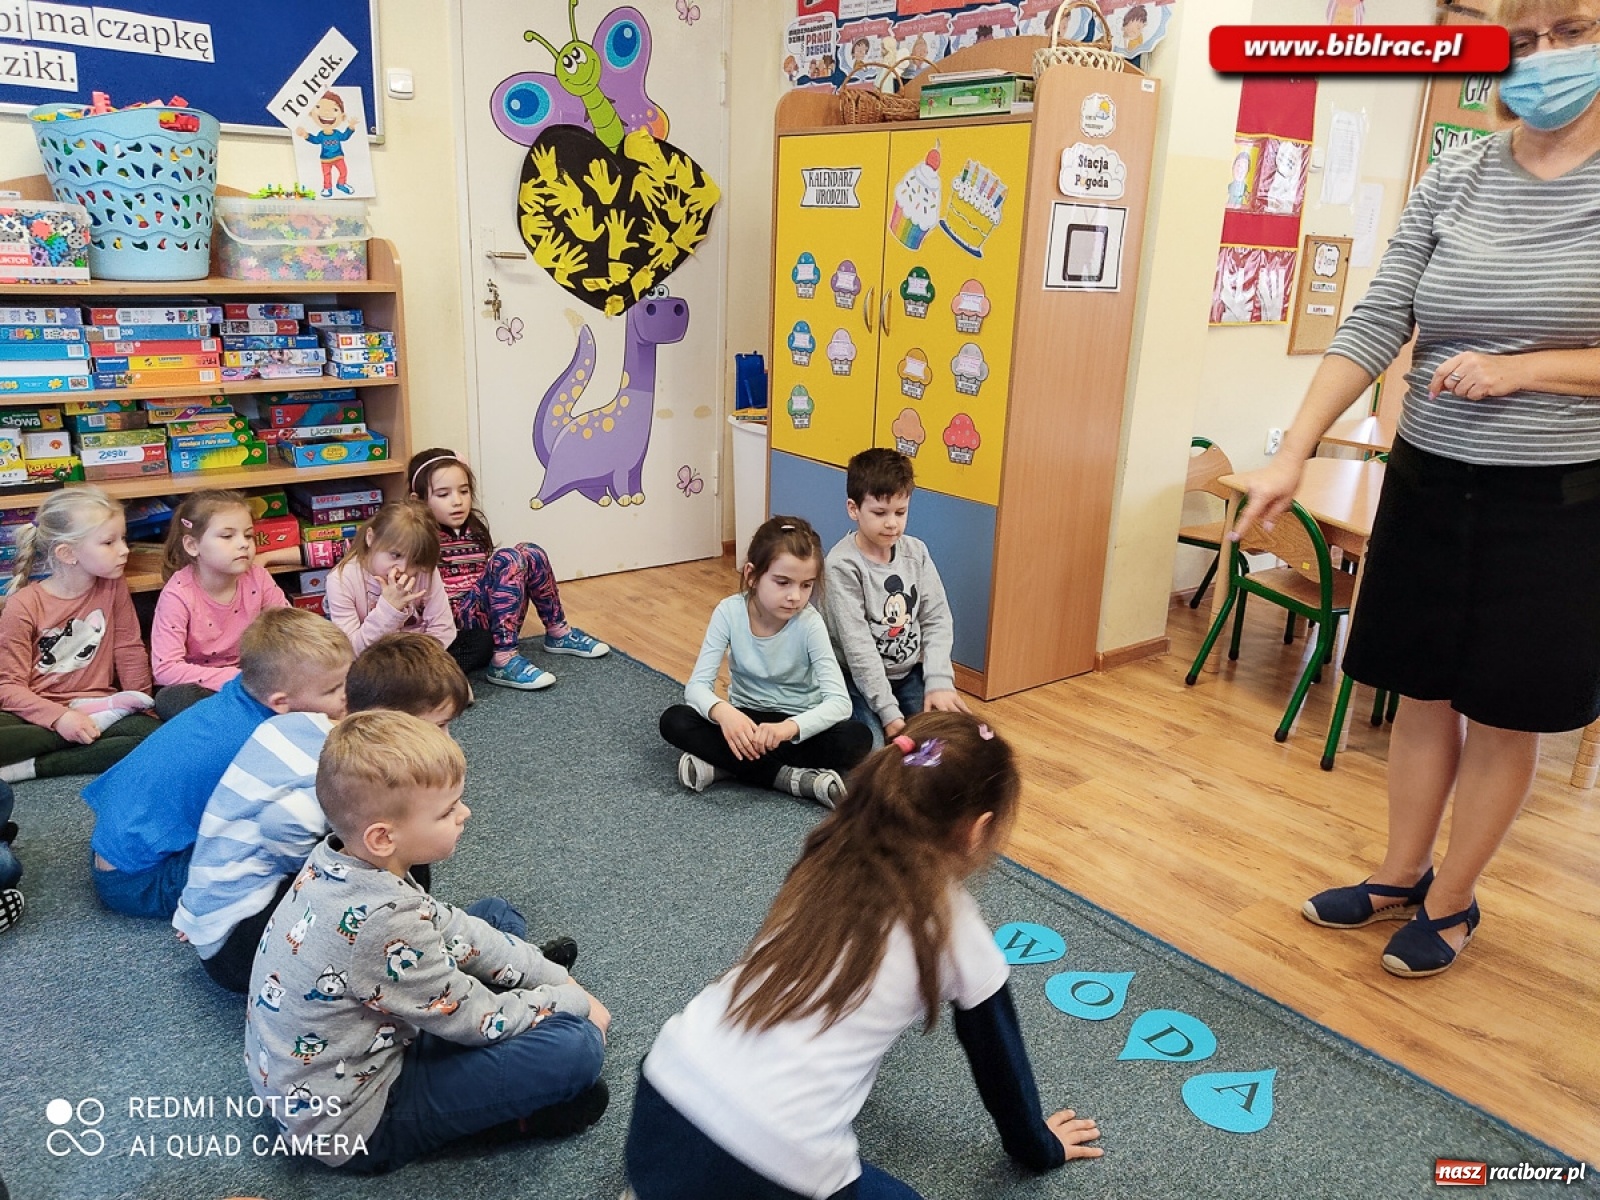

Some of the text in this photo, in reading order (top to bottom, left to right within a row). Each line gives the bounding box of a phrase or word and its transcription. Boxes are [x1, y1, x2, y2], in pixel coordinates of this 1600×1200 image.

[36, 11, 89, 37] ma
[96, 18, 209, 60] czapkę
[0, 51, 76, 83] ziki.
[281, 54, 344, 117] To Irek.
[1432, 127, 1482, 157] STA
[1078, 154, 1109, 174] Stacja
[808, 171, 854, 188] KALENDARZ
[1074, 174, 1109, 190] Pgoda
[815, 188, 849, 205] URODZIN
[1, 416, 41, 427] Słowa
